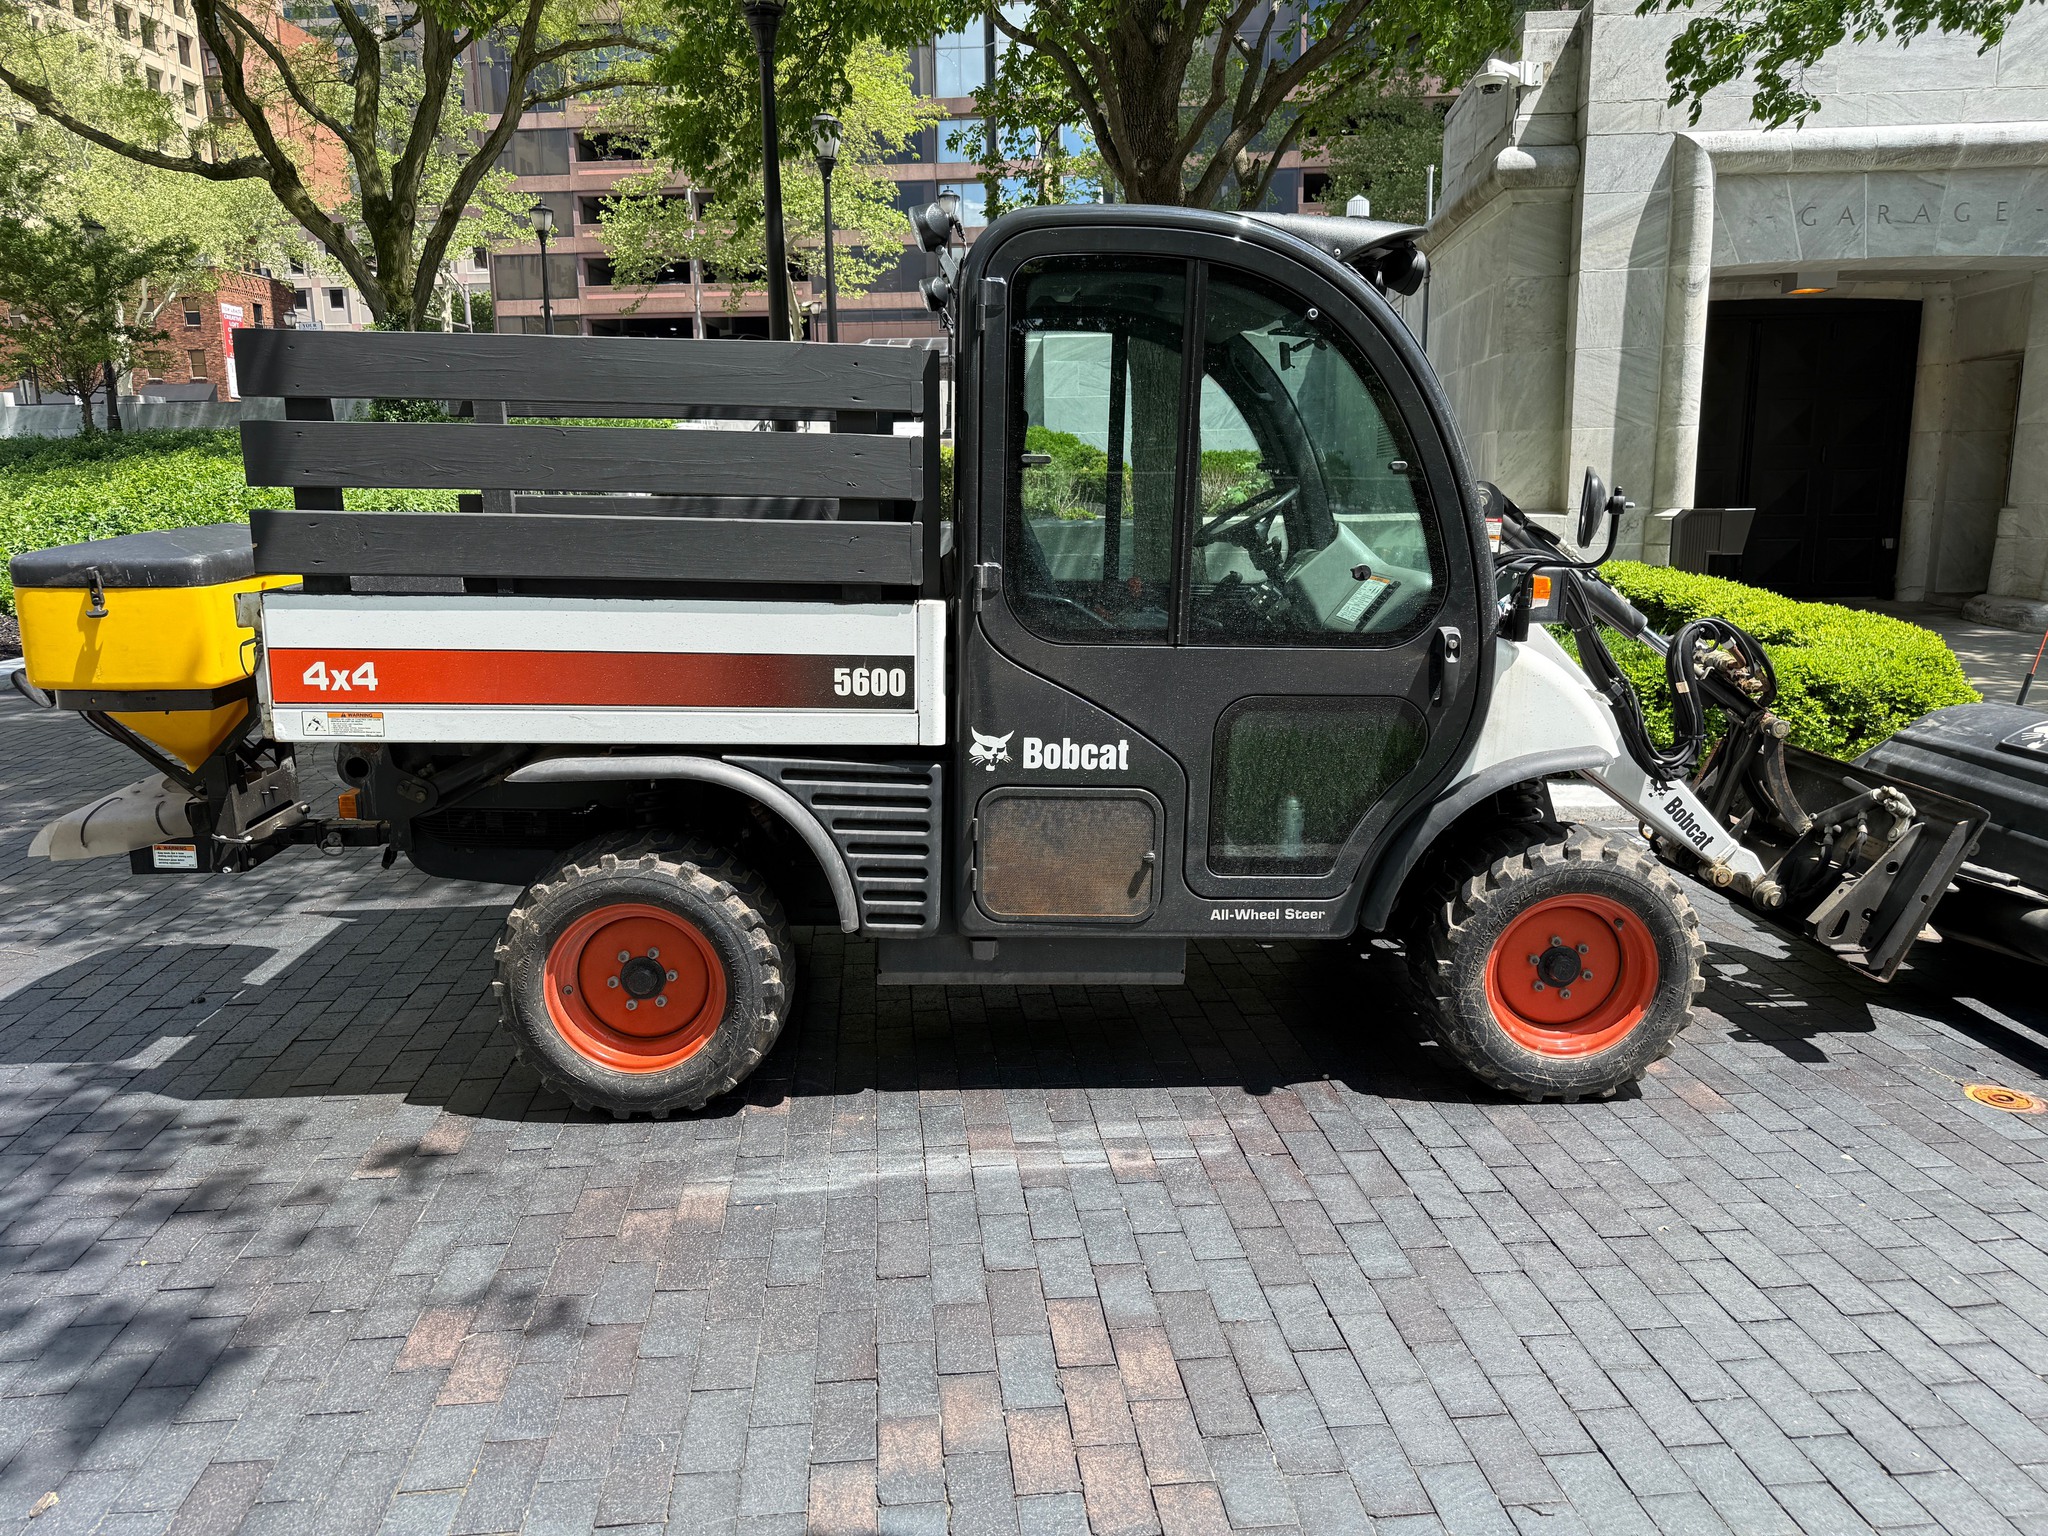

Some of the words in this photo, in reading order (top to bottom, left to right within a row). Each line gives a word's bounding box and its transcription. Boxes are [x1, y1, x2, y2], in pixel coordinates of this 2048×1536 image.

[1800, 200, 2009, 227] GARAGE
[302, 661, 379, 691] 4x4
[833, 668, 906, 697] 5600
[1022, 737, 1130, 771] Bobcat
[1663, 796, 1715, 852] Bobcat
[1210, 908, 1280, 921] All-Wheel
[1284, 908, 1326, 920] Steer
